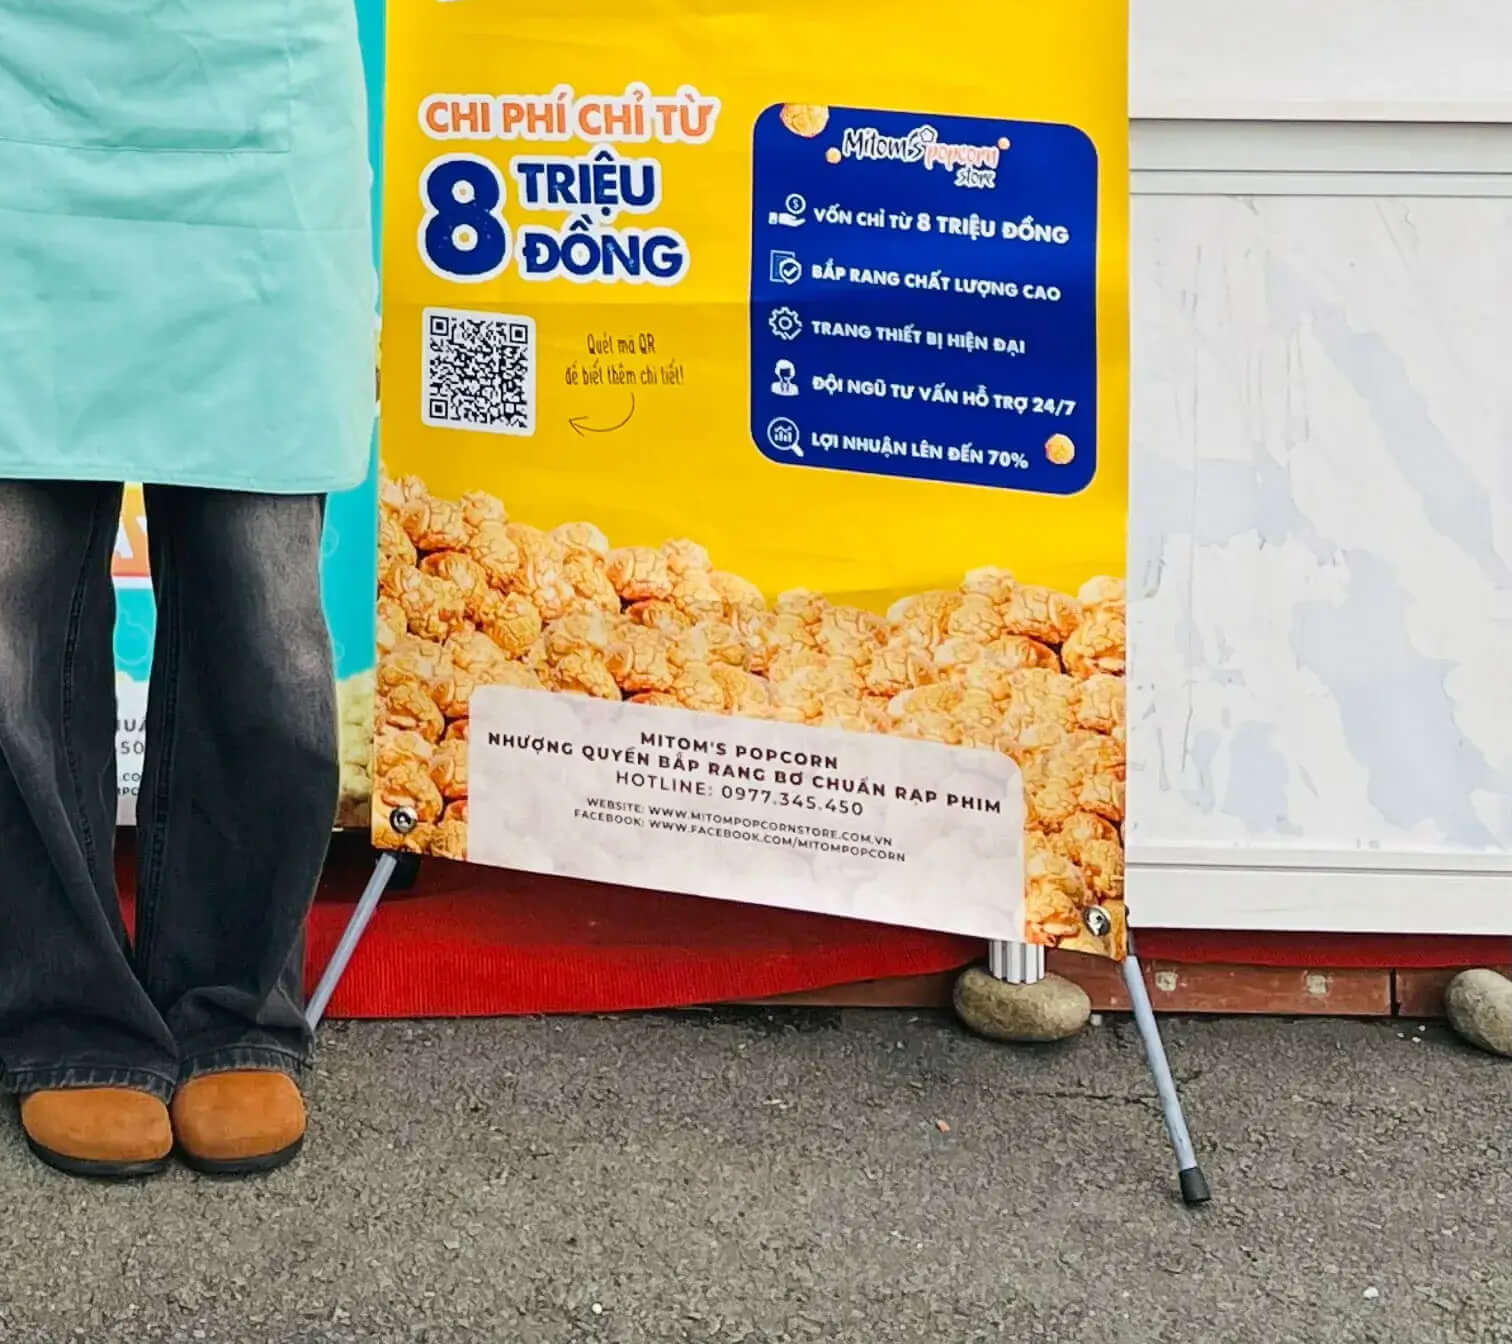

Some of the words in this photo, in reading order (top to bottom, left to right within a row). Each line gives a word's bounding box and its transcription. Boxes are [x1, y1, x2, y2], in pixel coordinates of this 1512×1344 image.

[425, 100, 491, 133] CHI
[502, 92, 567, 134] PHÍ
[577, 89, 644, 136] CHỈ
[656, 93, 714, 137] TỪ
[516, 149, 656, 217] TRIỆU
[424, 159, 507, 276] 8
[812, 203, 853, 225] VỐN
[856, 208, 885, 229] CHỈ
[916, 213, 932, 233] 8
[936, 214, 996, 241] TRIỆU
[522, 213, 684, 279] ĐỒNG
[849, 263, 901, 287] RANG
[1022, 284, 1062, 301] CAO
[638, 332, 656, 354] QR
[811, 320, 872, 340] TRANG
[890, 382, 915, 400] TƯ
[1032, 397, 1077, 418] 24/7
[842, 438, 908, 459] NHUẬN
[911, 439, 944, 460] LÊN
[988, 449, 1030, 470] 70%
[640, 731, 728, 757] MITOM'S
[735, 744, 839, 770] POPCORN
[487, 731, 574, 757] NHƯỢNG
[708, 762, 766, 782] RANG
[774, 769, 804, 787] BƠ
[946, 792, 1002, 814] PHIM
[615, 770, 713, 797] HOTLINE:
[720, 784, 865, 817] 0977.345.450
